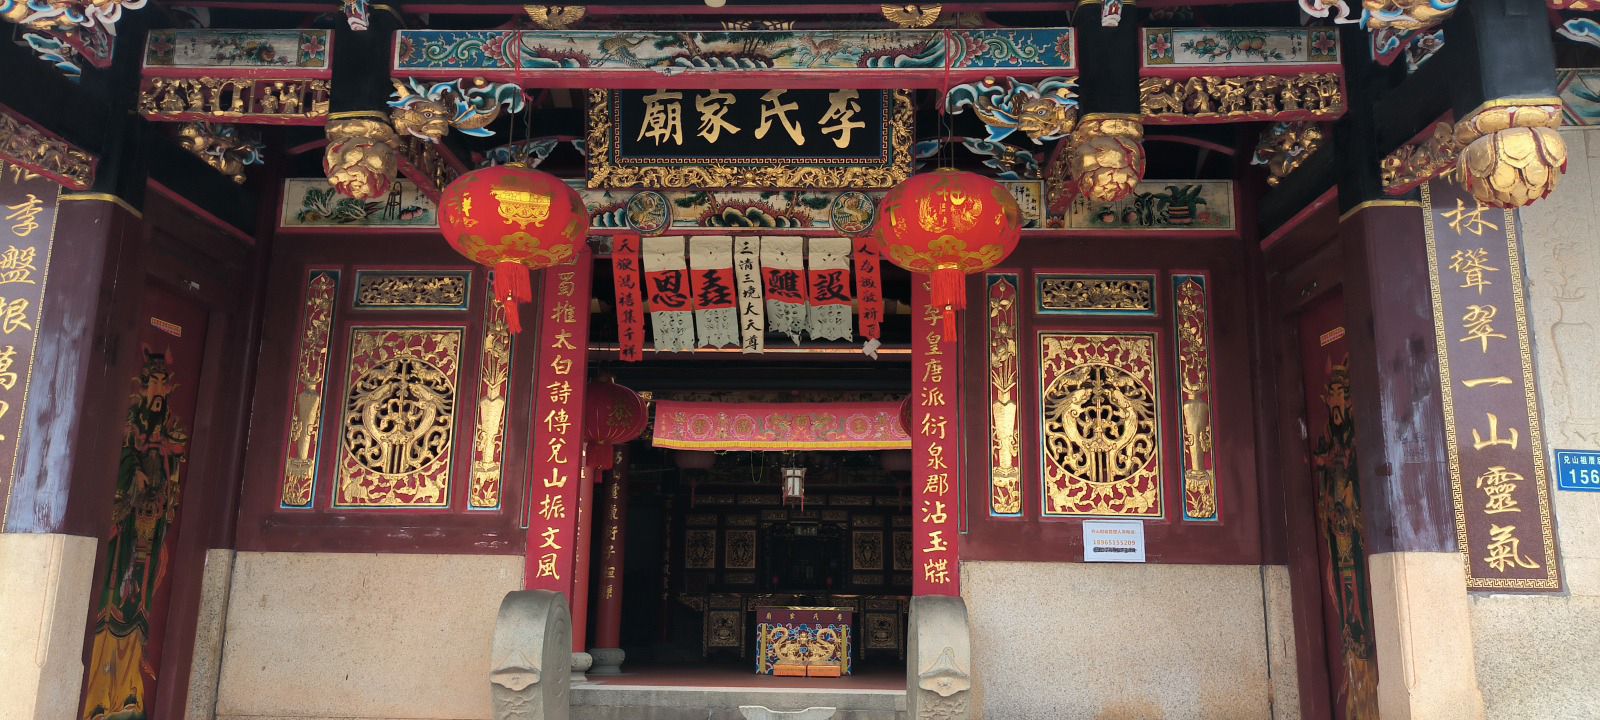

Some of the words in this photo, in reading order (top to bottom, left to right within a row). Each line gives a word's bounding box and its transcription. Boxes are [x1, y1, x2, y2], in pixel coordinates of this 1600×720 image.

[738, 241, 762, 350] 三清三境大天尊
[1440, 167, 1541, 573] 林聳翠一山靈氣
[1569, 469, 1600, 484] 156
